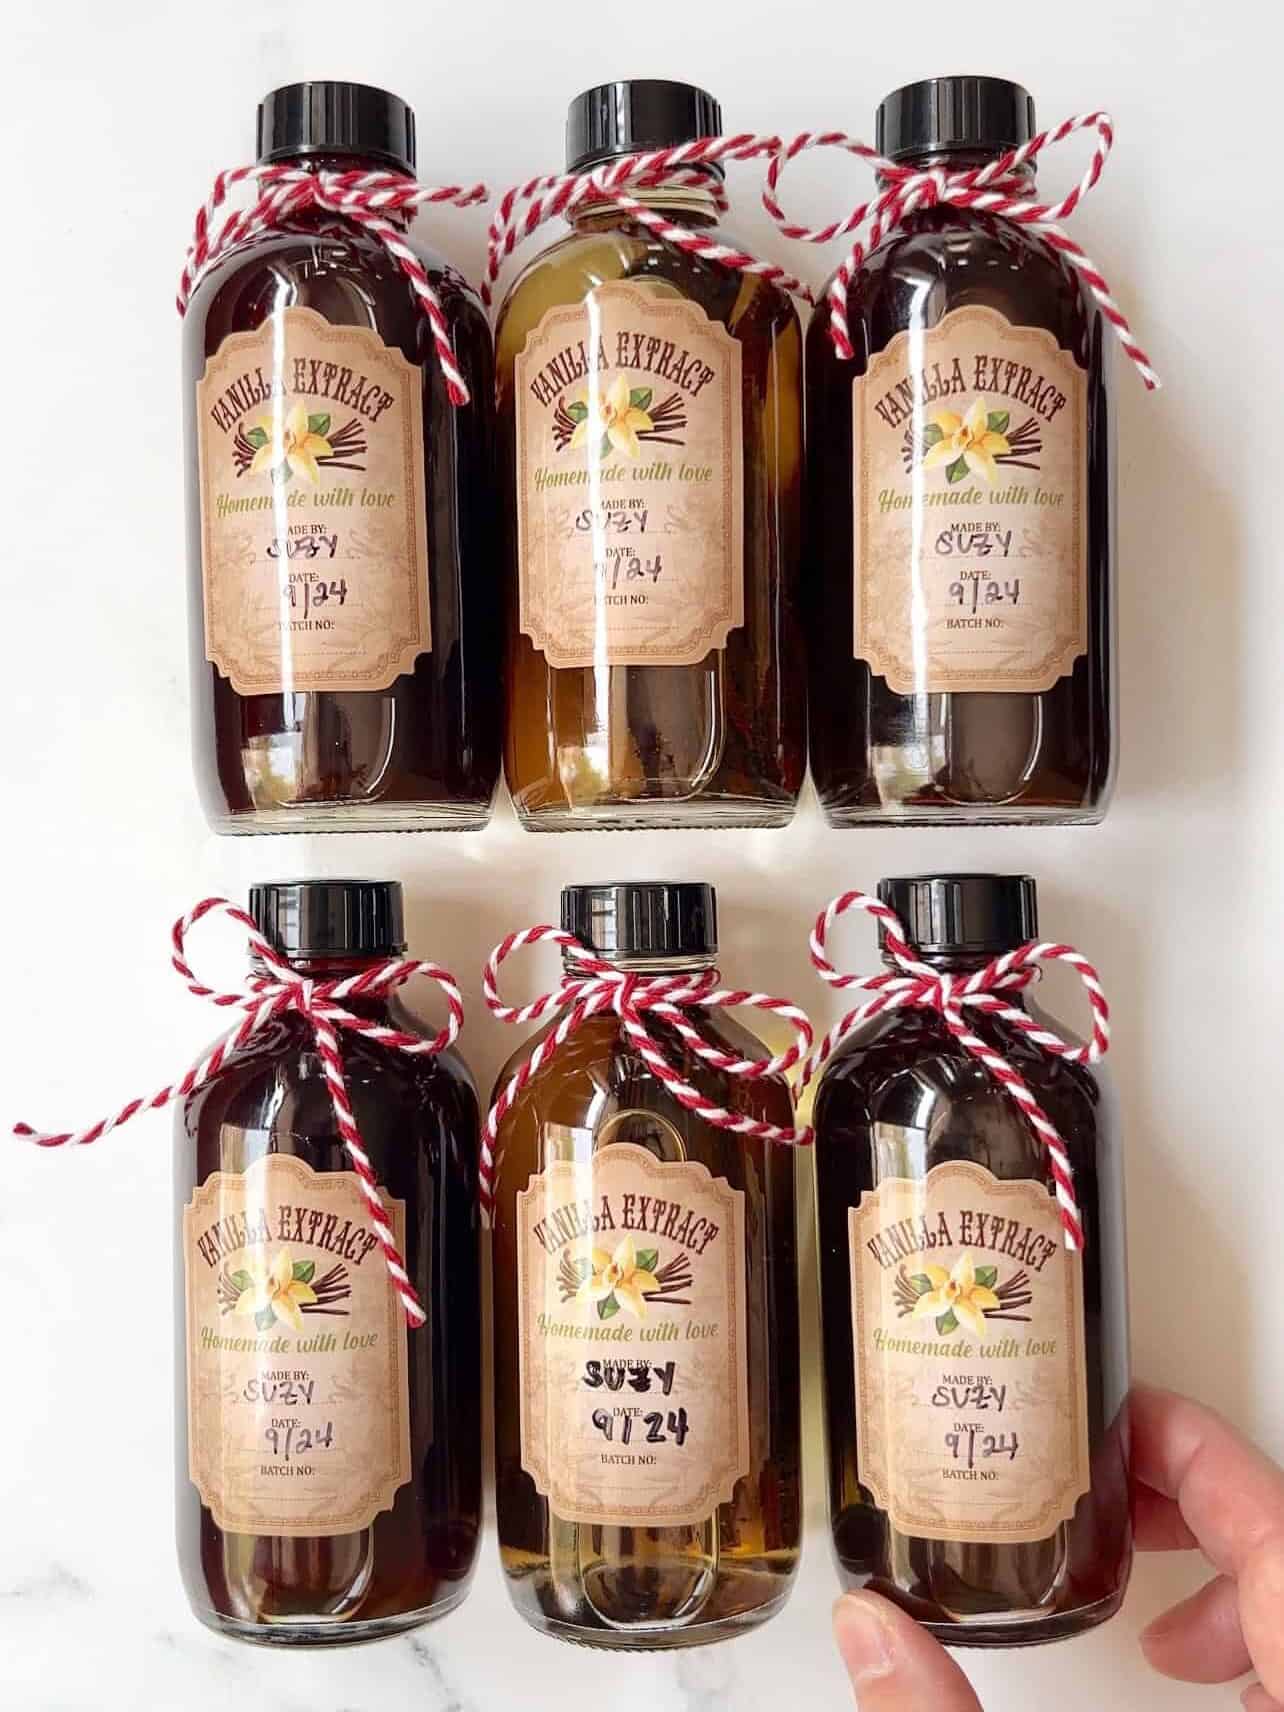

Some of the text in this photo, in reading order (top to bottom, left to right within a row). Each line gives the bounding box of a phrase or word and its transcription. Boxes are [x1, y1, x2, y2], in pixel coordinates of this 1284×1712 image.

[616, 331, 715, 397] EXTRACT
[293, 357, 395, 423] EXTRACT
[874, 354, 1067, 428] VANLLA EXTRACT
[535, 461, 713, 493] Homemde with love
[216, 487, 394, 518] Homemde with love
[629, 498, 645, 509] BY:
[989, 486, 1027, 506] with
[1033, 487, 1063, 505] love
[285, 524, 327, 535] ADE BY:
[951, 523, 1001, 533] MADE BY:
[606, 547, 635, 558] DATE:
[935, 530, 1012, 557] SUZY
[289, 573, 320, 583] DATE:
[594, 554, 662, 590] /24
[960, 571, 991, 581] DATE:
[283, 578, 347, 619] 9/24
[594, 595, 648, 605] TCH NO:
[949, 577, 1020, 614] 9/24
[278, 620, 335, 631] ATCH NO:
[947, 619, 1004, 629] BATCH NO:
[621, 1193, 720, 1255] EXTRACT
[197, 1205, 379, 1268] VANILLA EXTRACT
[867, 1210, 1057, 1272] VANILLA EXTRACT
[537, 1312, 719, 1342] Homemade with love
[296, 1333, 336, 1354] with
[343, 1333, 378, 1350] love
[872, 1327, 973, 1358] Homemade
[980, 1339, 1019, 1359] with
[602, 1359, 634, 1369] MADE
[262, 1370, 310, 1380] MADE BY:
[582, 1360, 675, 1396] SUZY
[942, 1375, 992, 1385] MADE BY:
[243, 1378, 315, 1406] SUZY
[932, 1384, 1006, 1412] SUZY
[271, 1418, 301, 1428] DATE:
[613, 1408, 643, 1417] DATE:
[953, 1423, 984, 1433] DATE:
[265, 1421, 333, 1462] 9/24
[945, 1429, 1019, 1469] 9/24
[260, 1465, 315, 1475] BATCH NO:
[601, 1454, 657, 1465] BATCH NO:
[942, 1470, 999, 1480] BATCH NO:
